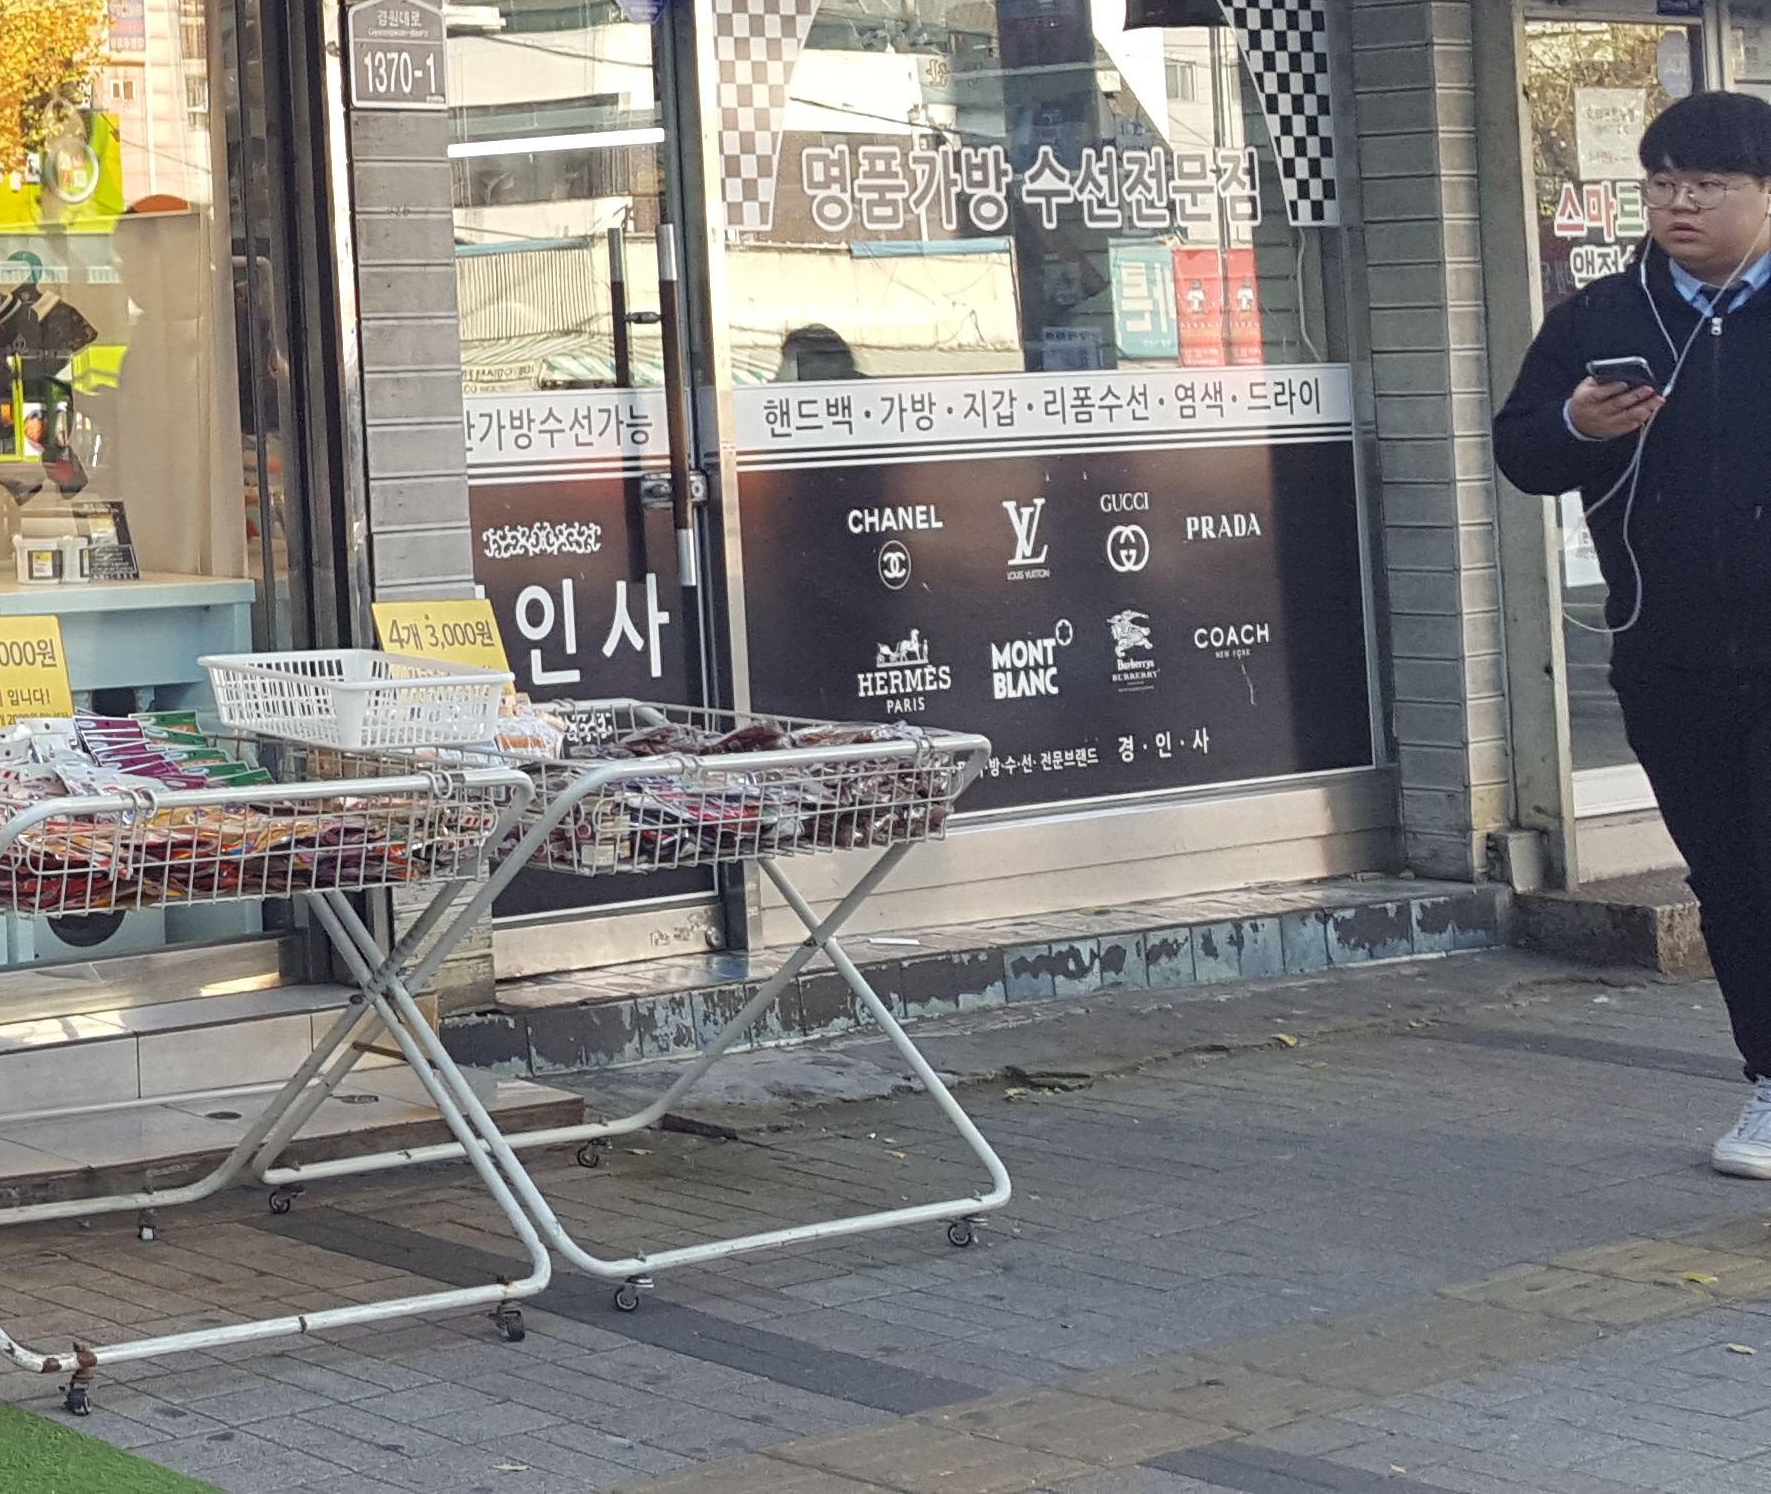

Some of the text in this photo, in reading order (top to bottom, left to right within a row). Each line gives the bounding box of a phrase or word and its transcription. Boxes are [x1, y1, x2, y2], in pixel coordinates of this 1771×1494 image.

[378, 10, 422, 27] 경원대로
[364, 51, 436, 94] 1370-1
[1555, 181, 1647, 242] 스마트
[1100, 492, 1149, 512] GUCCI
[847, 505, 944, 534] CHANEL
[1185, 513, 1261, 542] PRADA
[389, 619, 496, 651] 4개 3,000원
[1194, 623, 1270, 649] COACH
[991, 638, 1057, 671] MONT
[7, 688, 51, 706] 입니다!
[993, 667, 1059, 700] BLANC
[886, 697, 926, 714] PARIS
